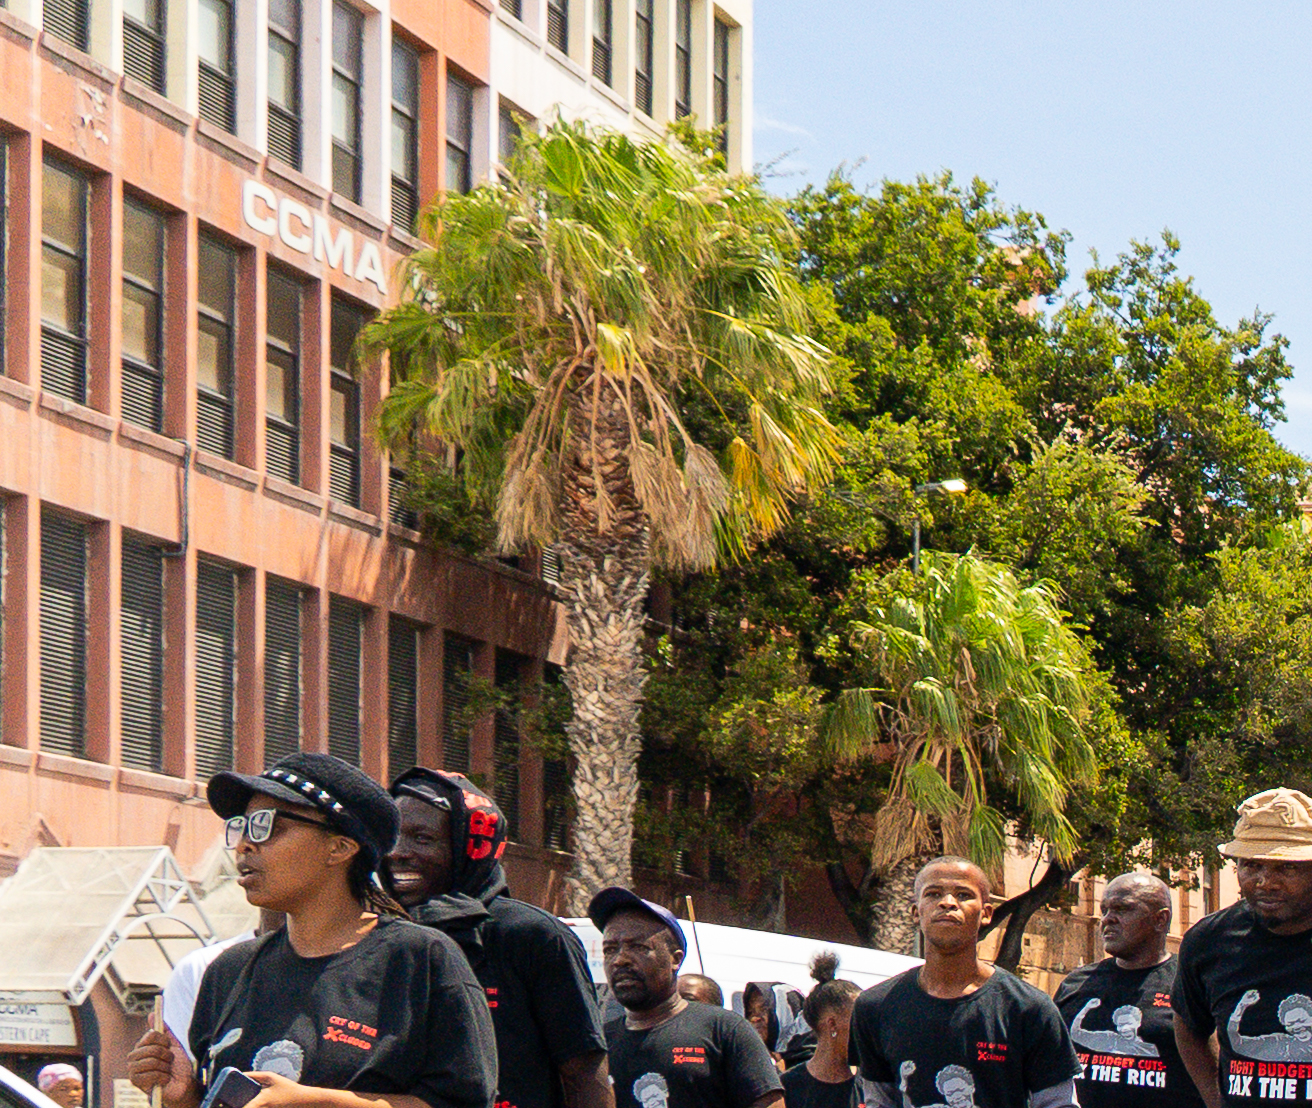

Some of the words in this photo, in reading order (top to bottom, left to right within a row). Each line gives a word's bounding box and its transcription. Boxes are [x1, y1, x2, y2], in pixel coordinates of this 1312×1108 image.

[242, 179, 388, 296] CCMA
[1091, 1055, 1135, 1069] BUDGET
[1229, 1060, 1255, 1075] FIGHT
[1091, 1065, 1121, 1083] THE
[1127, 1068, 1166, 1088] RICH
[1228, 1074, 1254, 1097] TAX
[1258, 1077, 1298, 1099] THE
